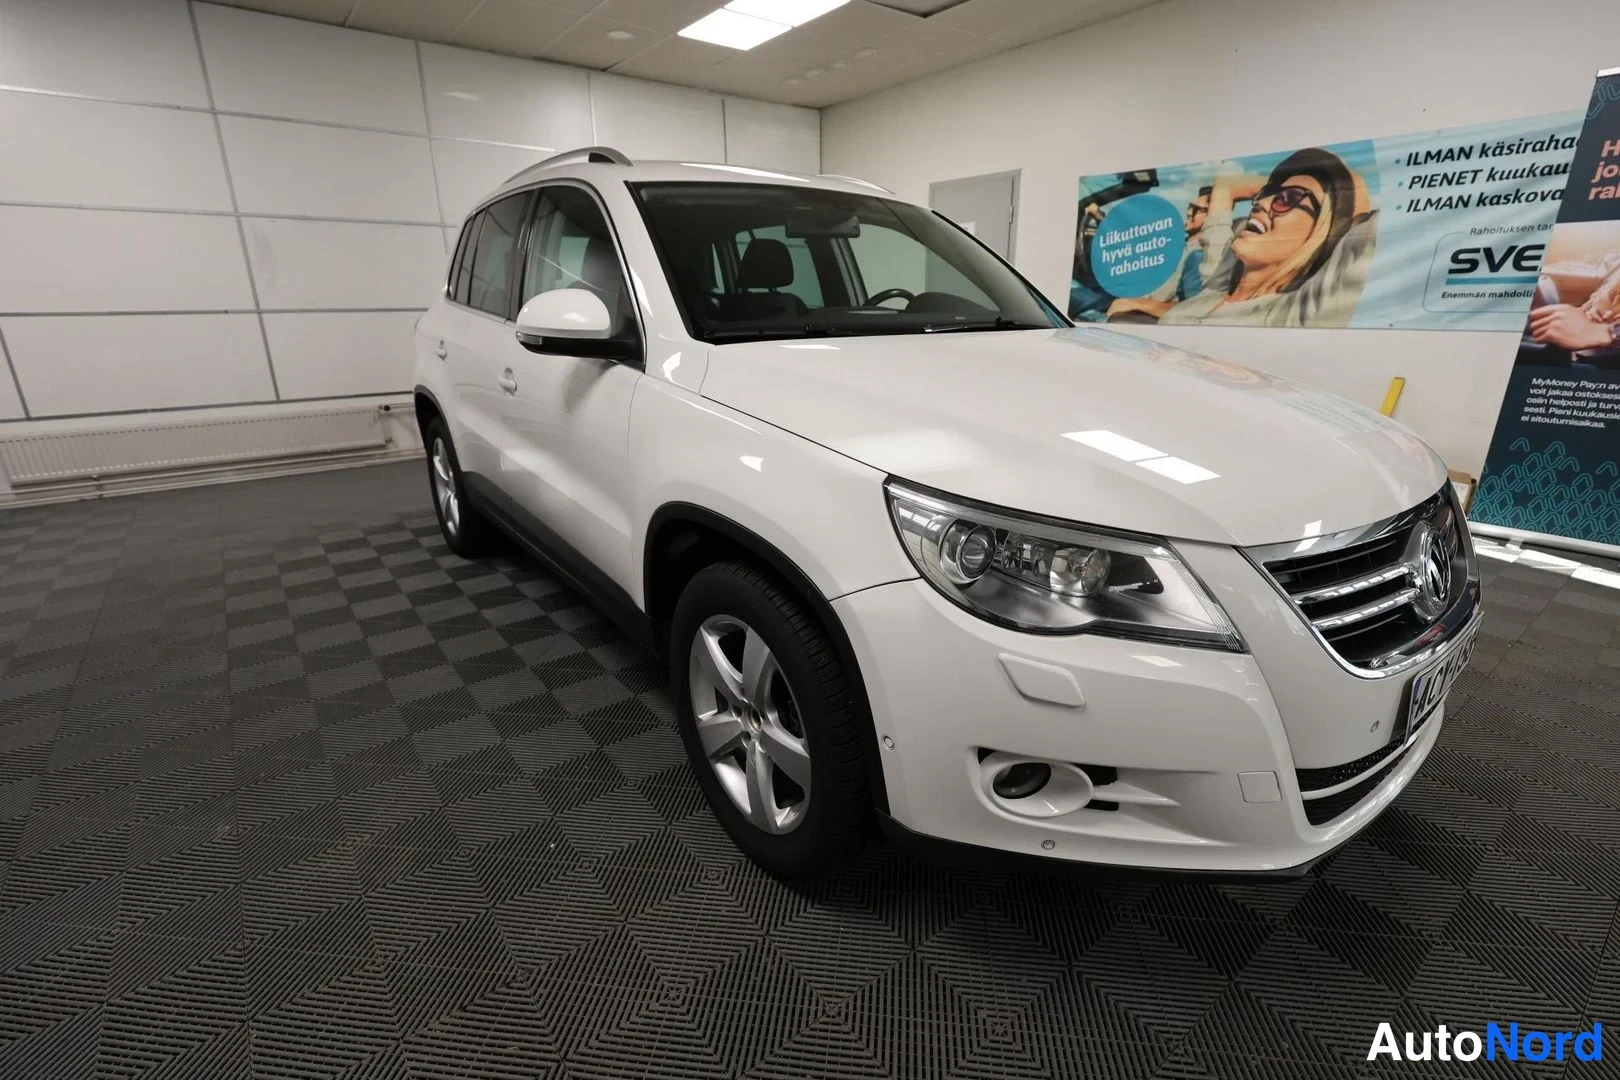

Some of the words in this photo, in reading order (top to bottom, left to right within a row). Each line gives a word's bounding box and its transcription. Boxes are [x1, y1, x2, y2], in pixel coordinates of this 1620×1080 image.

[1406, 145, 1473, 167] ILMAN
[1408, 169, 1483, 189] PIENET
[1591, 161, 1620, 183] jo
[1406, 194, 1472, 213] ILMAN
[1100, 217, 1173, 248] Liikuttavan
[1470, 226, 1535, 236] Rahoituksen
[1102, 243, 1132, 263] hyvä
[1135, 236, 1172, 253] auto-
[1448, 244, 1545, 274] SVE
[1110, 253, 1165, 277] rahoitus
[1442, 291, 1486, 299] Enemmän
[1532, 378, 1579, 388] MyMoney
[1547, 388, 1573, 396] jakaa
[1526, 397, 1547, 405] osiin
[1549, 398, 1587, 407] helposti
[1587, 400, 1597, 409] ja
[1548, 407, 1572, 416] Pieni
